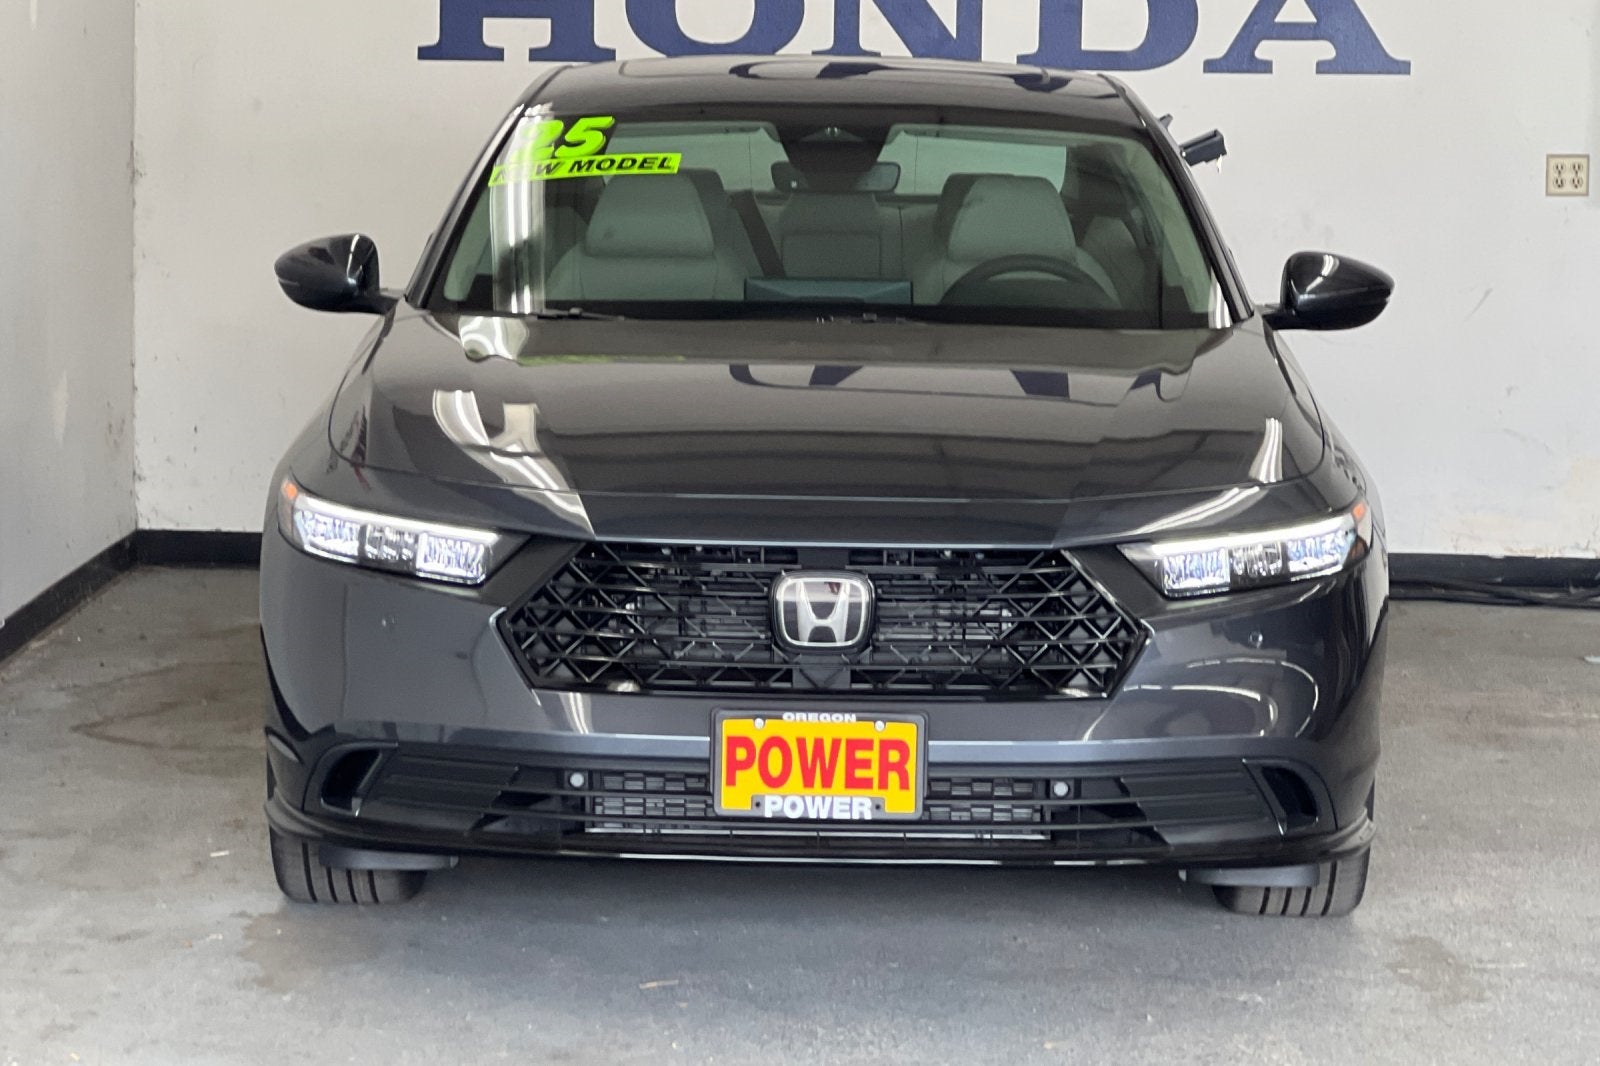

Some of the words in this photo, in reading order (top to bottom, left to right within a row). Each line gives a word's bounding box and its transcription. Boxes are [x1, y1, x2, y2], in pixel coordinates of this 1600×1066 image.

[418, 0, 1411, 75] HONDA
[511, 115, 616, 160] 25
[492, 160, 561, 182] NW
[568, 156, 674, 174] MODEL
[782, 711, 857, 723] OREGON
[725, 735, 911, 791] POWER
[764, 794, 872, 819] POWER
